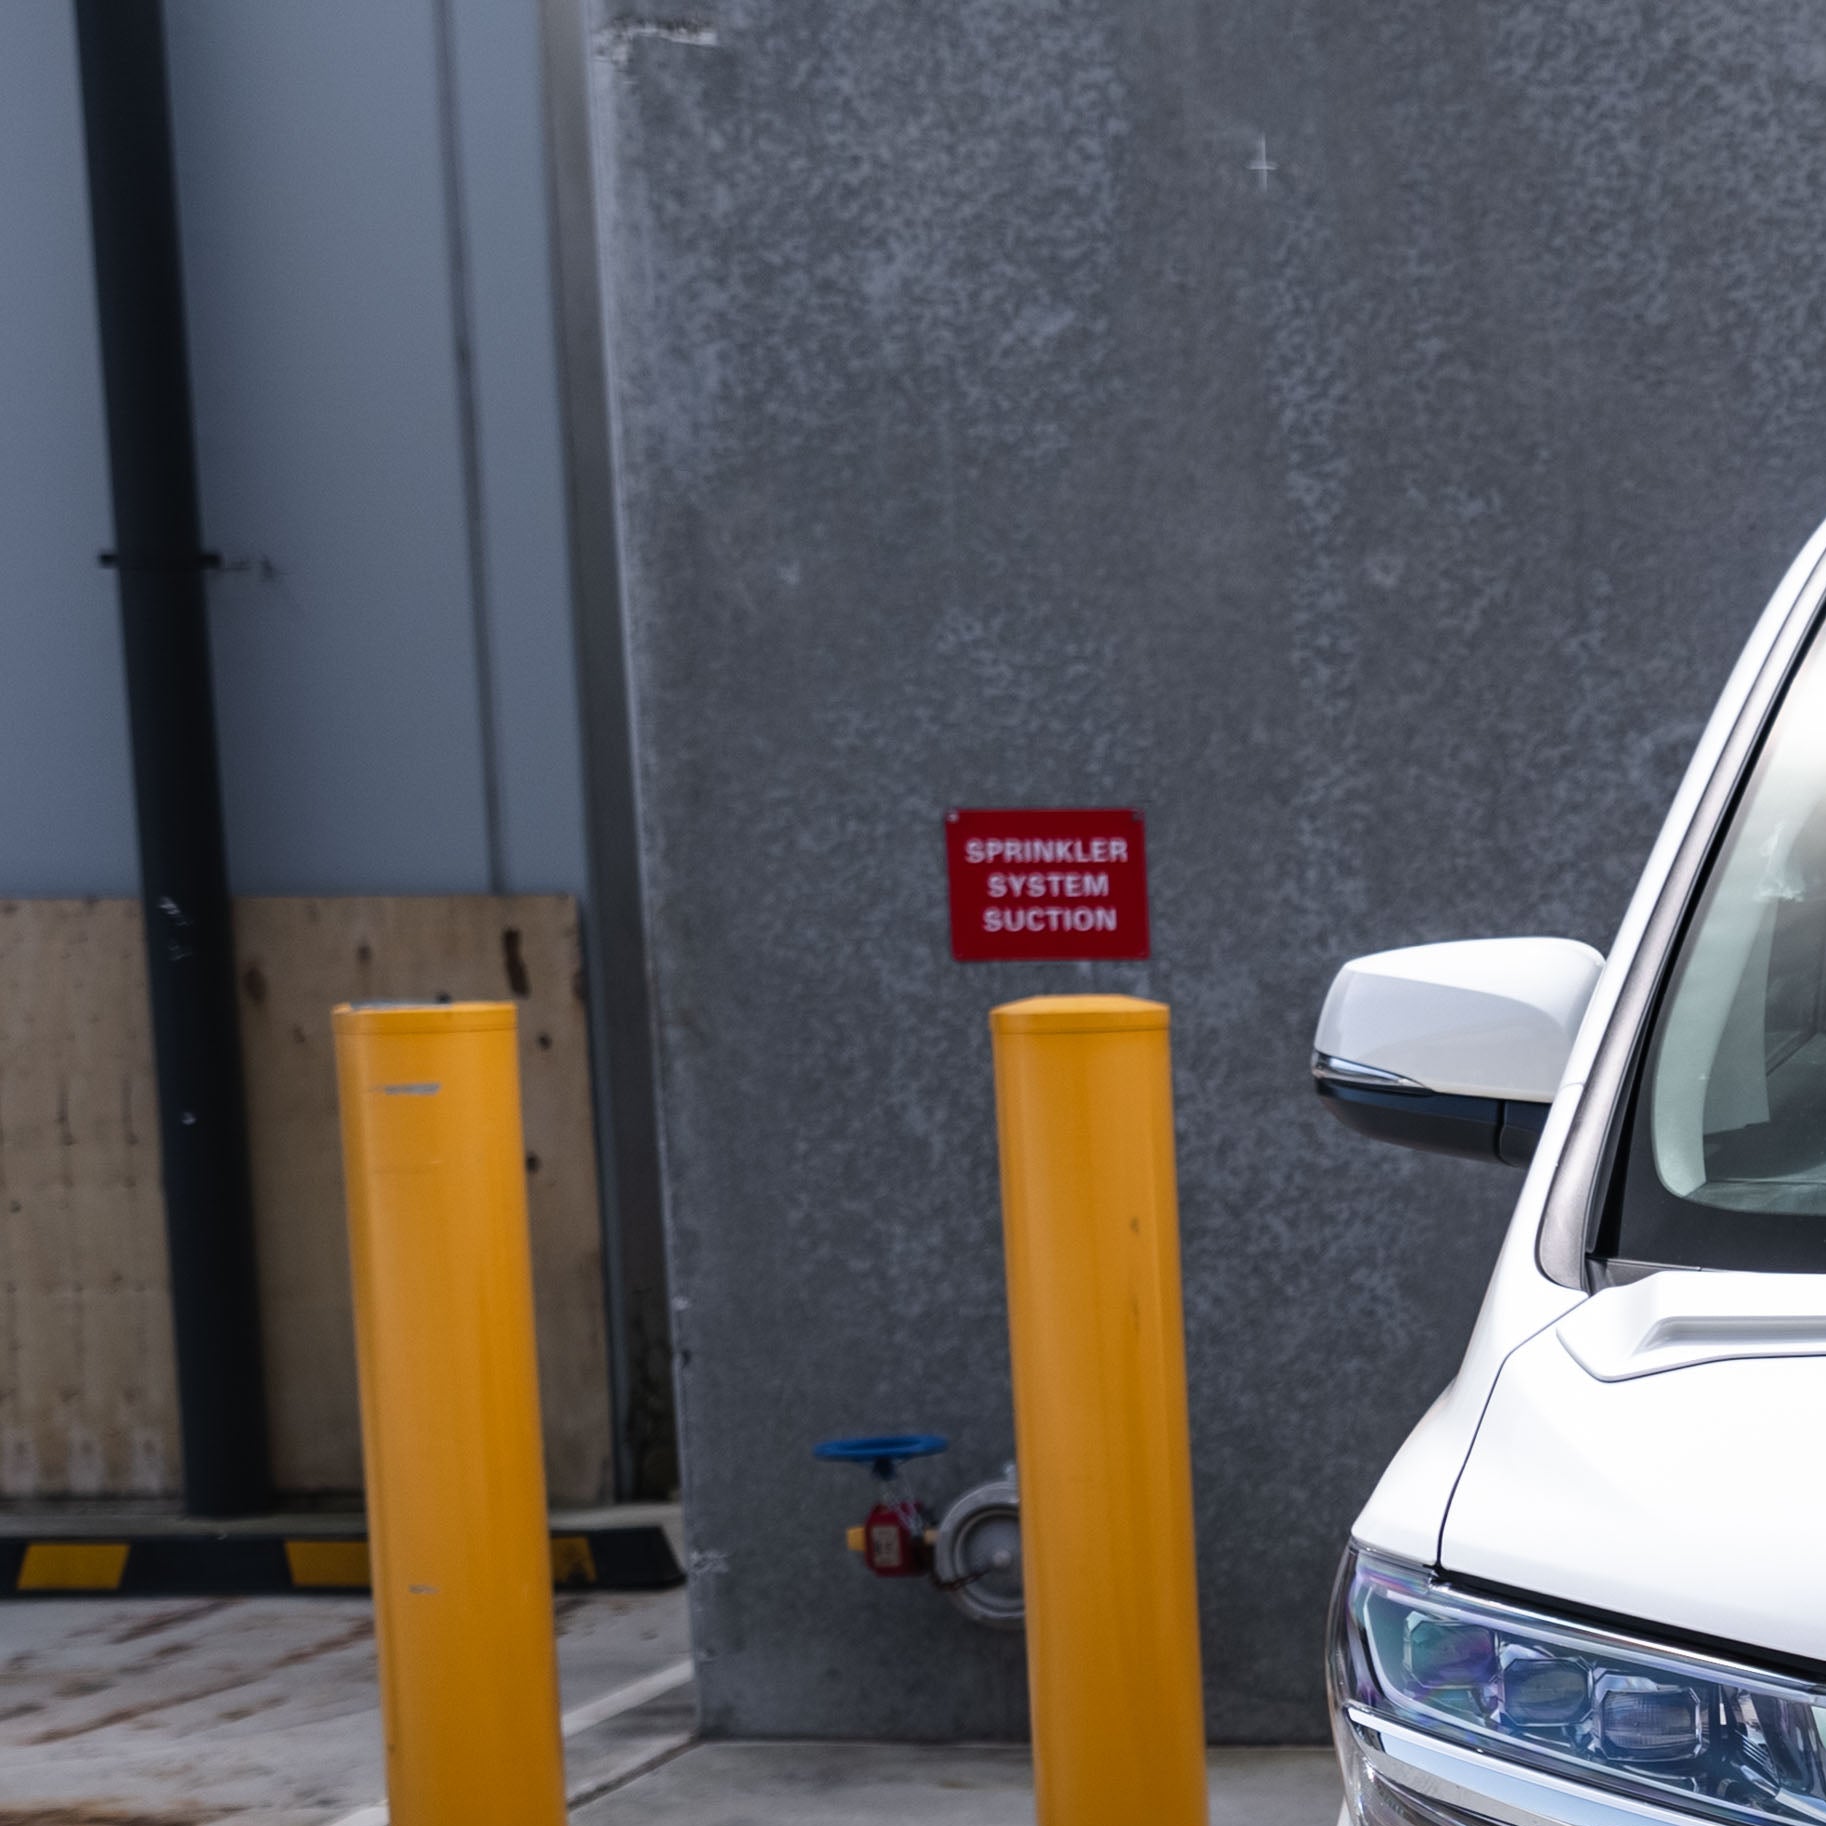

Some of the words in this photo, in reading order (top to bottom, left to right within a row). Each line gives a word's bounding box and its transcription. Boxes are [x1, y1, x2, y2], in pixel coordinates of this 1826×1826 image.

[965, 838, 1128, 864] SPRINKLER
[987, 872, 1109, 898] SYSTEM
[983, 906, 1117, 932] SUCTION
